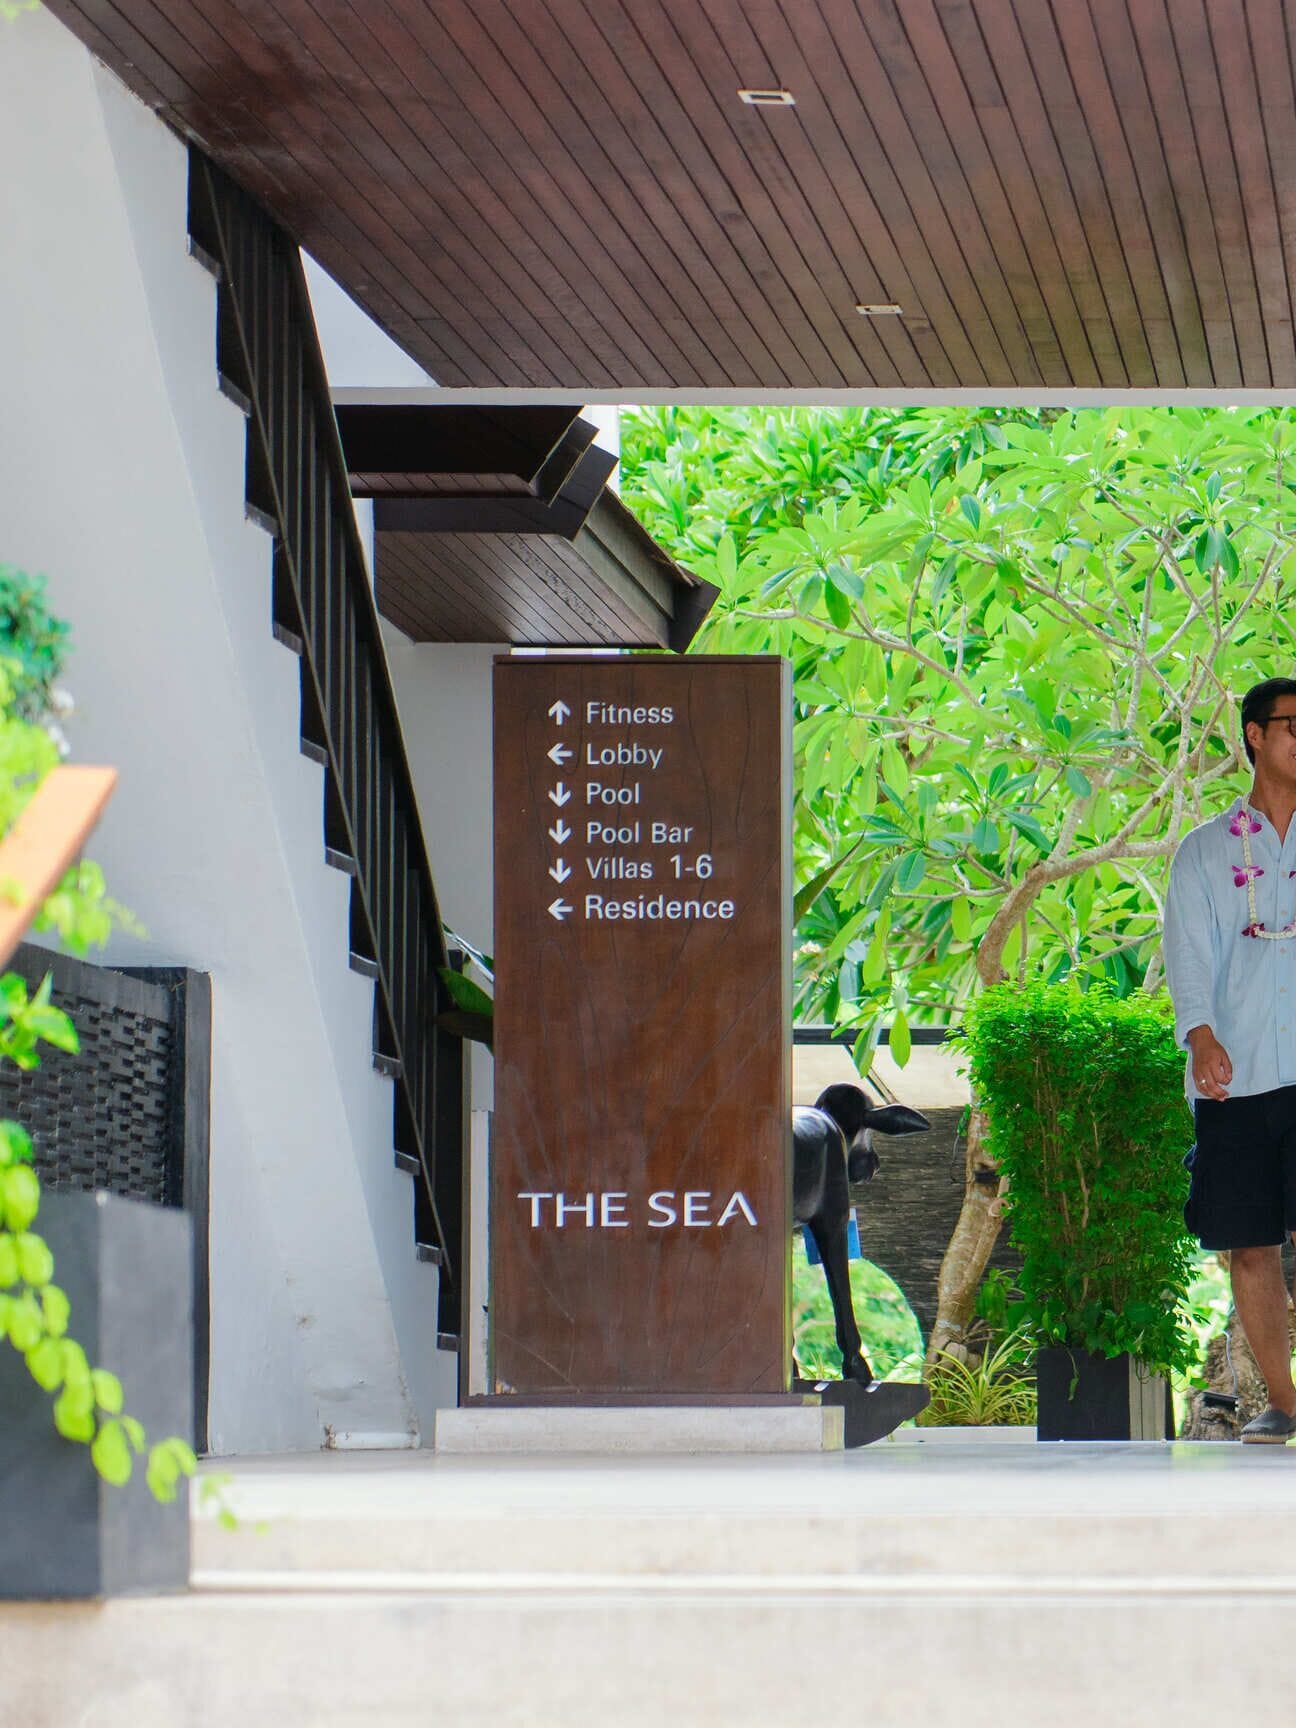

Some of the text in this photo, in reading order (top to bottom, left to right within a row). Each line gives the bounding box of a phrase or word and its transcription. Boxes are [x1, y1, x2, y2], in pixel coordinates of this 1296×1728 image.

[586, 701, 674, 724] Fitness
[586, 742, 663, 770] Lobby
[586, 782, 640, 805] Pool
[586, 821, 693, 844] Pool Bar
[585, 853, 713, 880] Villas 1-6
[585, 894, 735, 920] Residence
[517, 1191, 758, 1228] THE SEA
